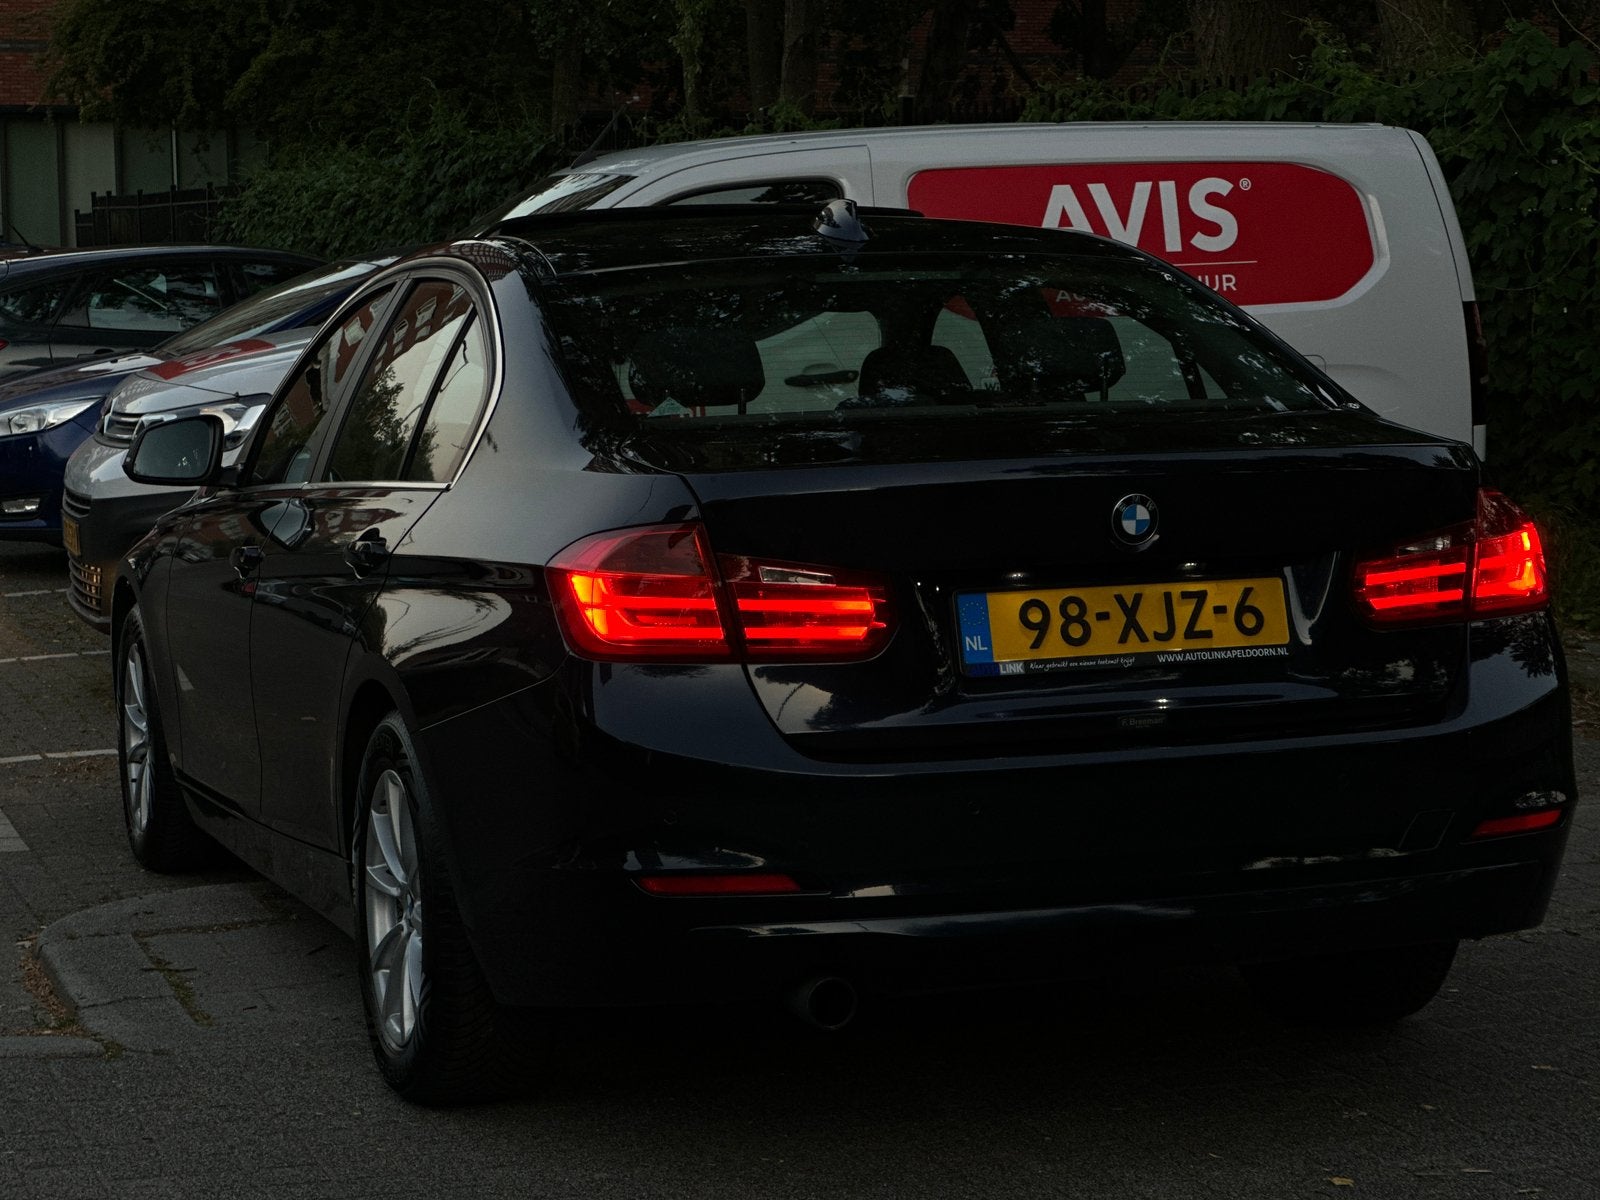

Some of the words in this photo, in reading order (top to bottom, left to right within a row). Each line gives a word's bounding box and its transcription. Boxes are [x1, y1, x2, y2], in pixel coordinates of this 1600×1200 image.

[1041, 177, 1239, 252] AVIS
[1197, 273, 1237, 292] UR
[1018, 587, 1265, 649] 98-XJZ-6
[965, 635, 988, 651] NL
[1157, 647, 1289, 662] WWW.AUTOLINKAPELDOORN.NL
